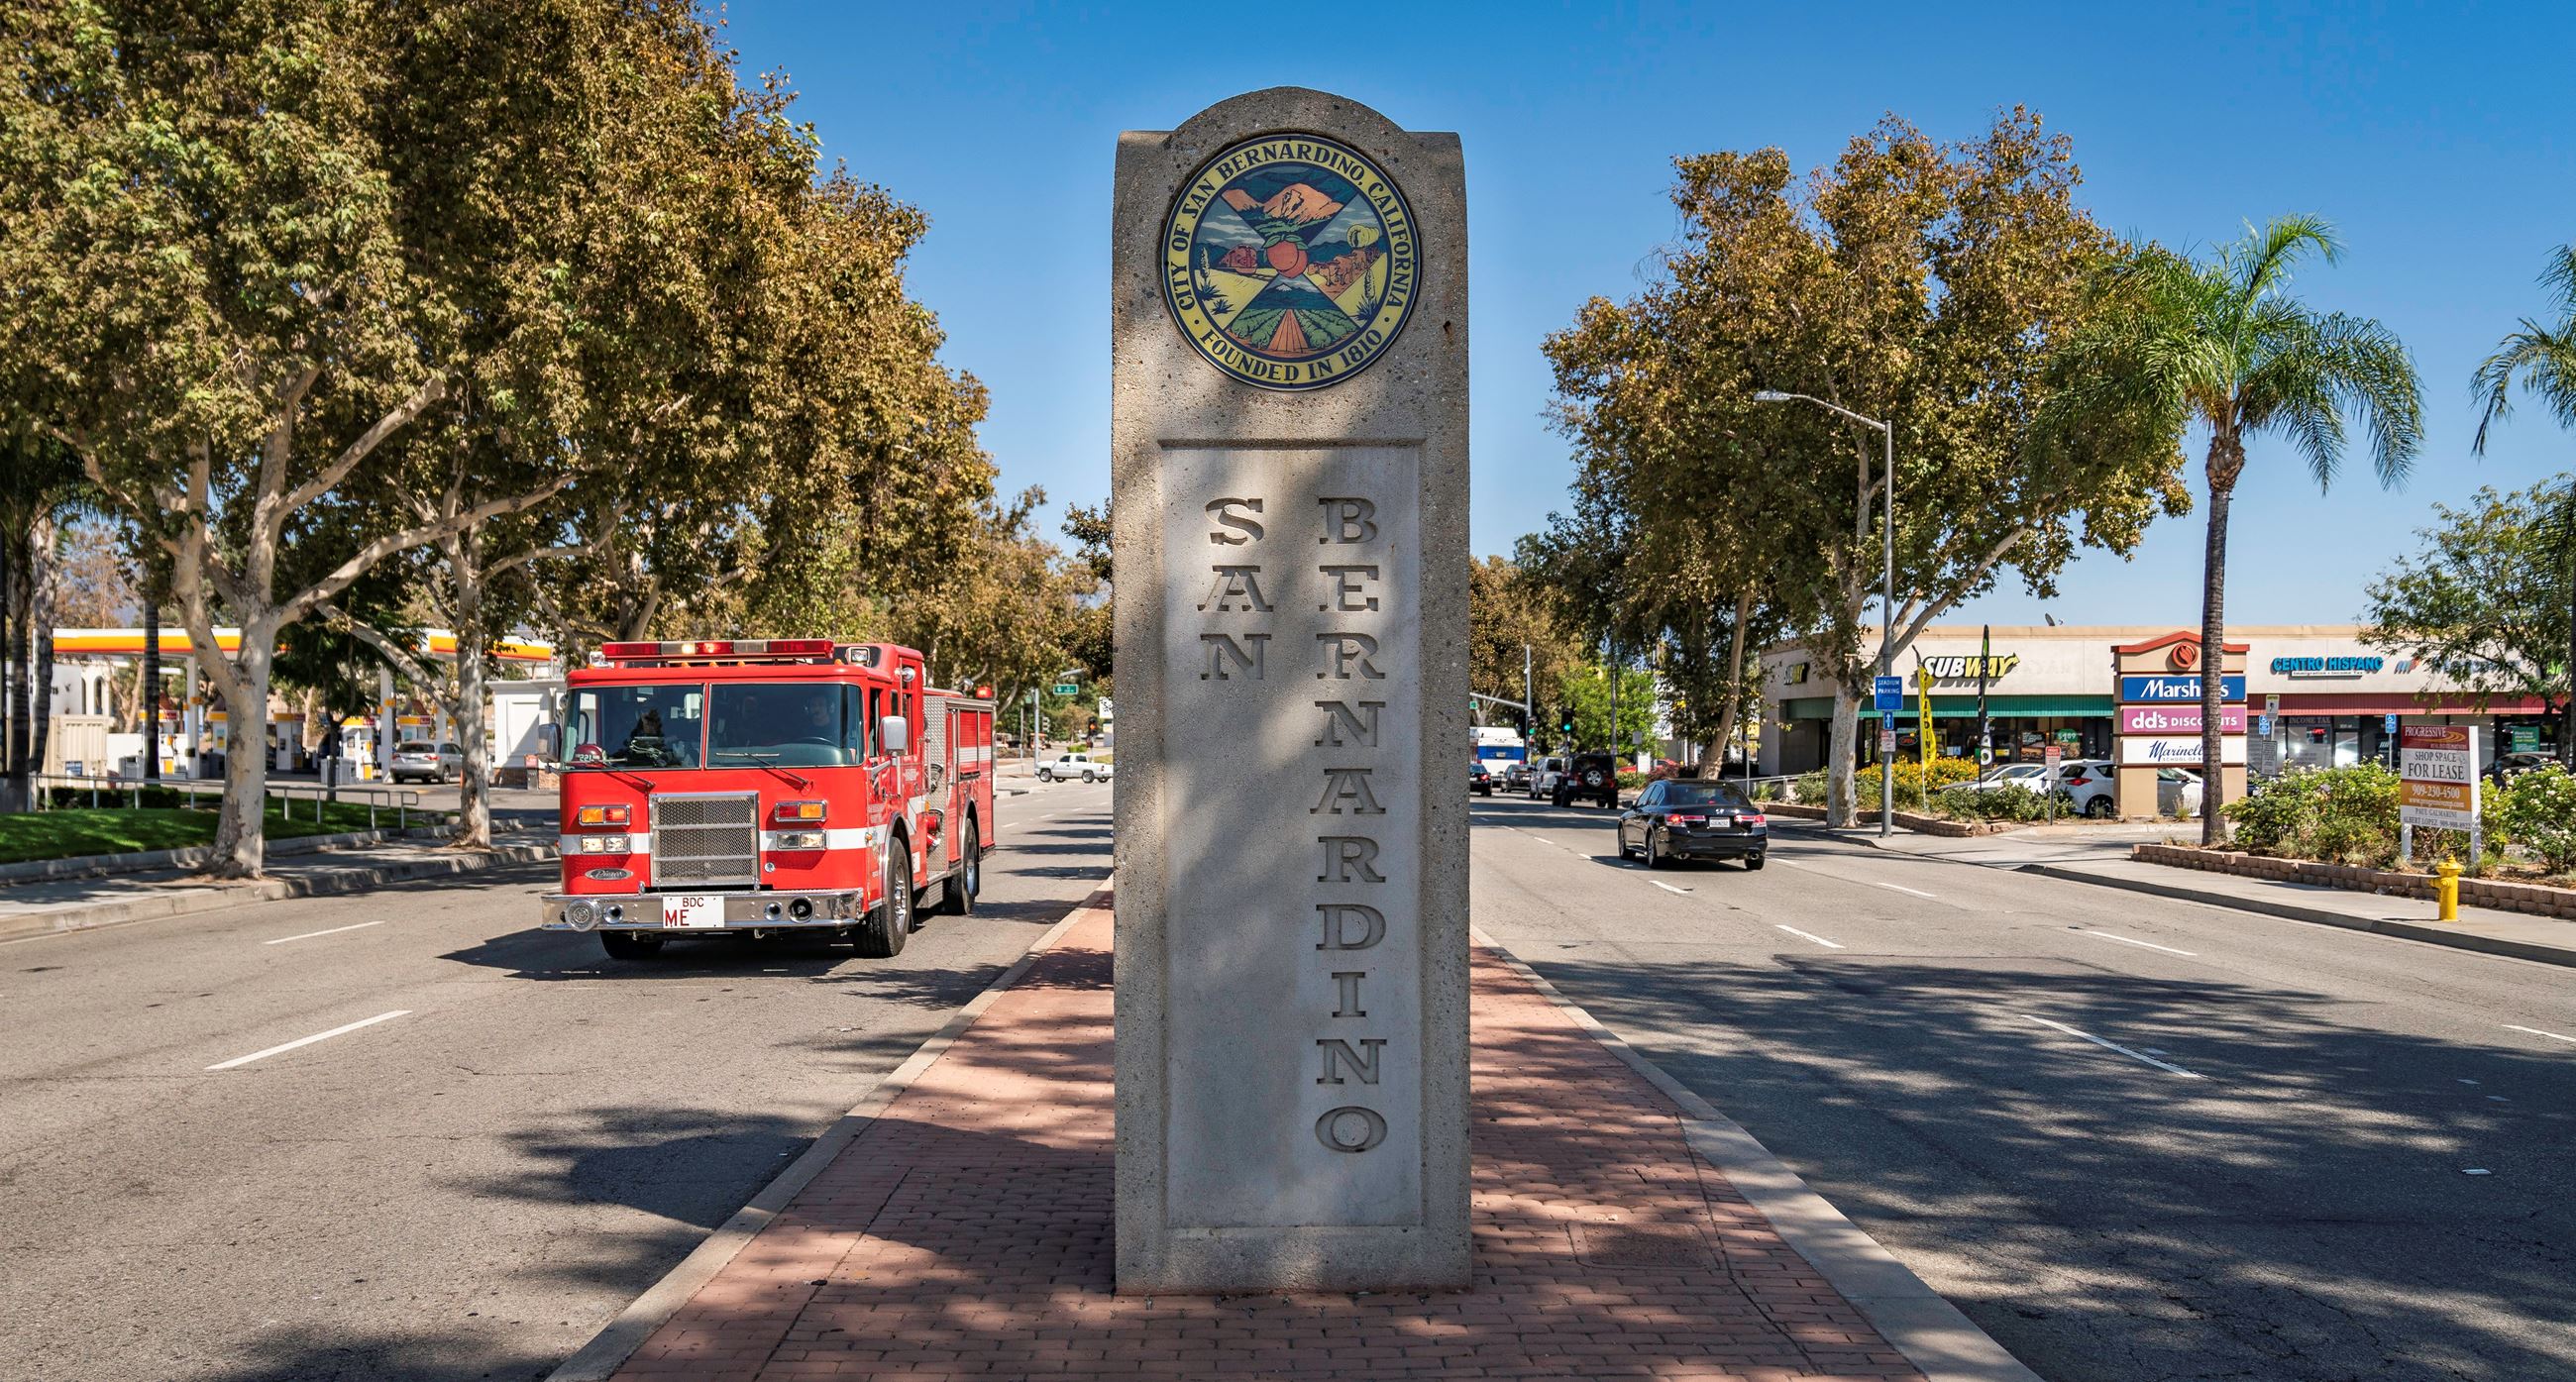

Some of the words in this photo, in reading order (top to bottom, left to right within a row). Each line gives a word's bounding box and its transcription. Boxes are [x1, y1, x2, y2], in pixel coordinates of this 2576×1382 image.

[1215, 143, 1365, 186] BERNARDINO,
[1182, 178, 1216, 219] SAN
[1172, 224, 1191, 252] OF
[1367, 180, 1412, 309] CALIFORNIA
[1171, 262, 1195, 310] CITY
[1200, 328, 1300, 381] FOUNDED
[1308, 359, 1333, 380] IN
[1341, 328, 1383, 366] 1810
[1197, 497, 1274, 681] SAN
[1923, 653, 2019, 679] SUBWAY
[2272, 657, 2324, 672] CENTRO
[2140, 680, 2229, 697] Marshs
[2131, 711, 2168, 729] dd's
[2405, 726, 2447, 737] PROGRESSIVE
[2149, 740, 2203, 762] Marinell
[2414, 751, 2433, 761] SHOP
[2434, 752, 2457, 763] SPACE
[2408, 762, 2429, 778] FOR
[2432, 764, 2465, 780] LEASE
[1309, 497, 1388, 1154] BERNARDINO
[682, 897, 704, 907] BDC
[665, 908, 690, 926] ME
